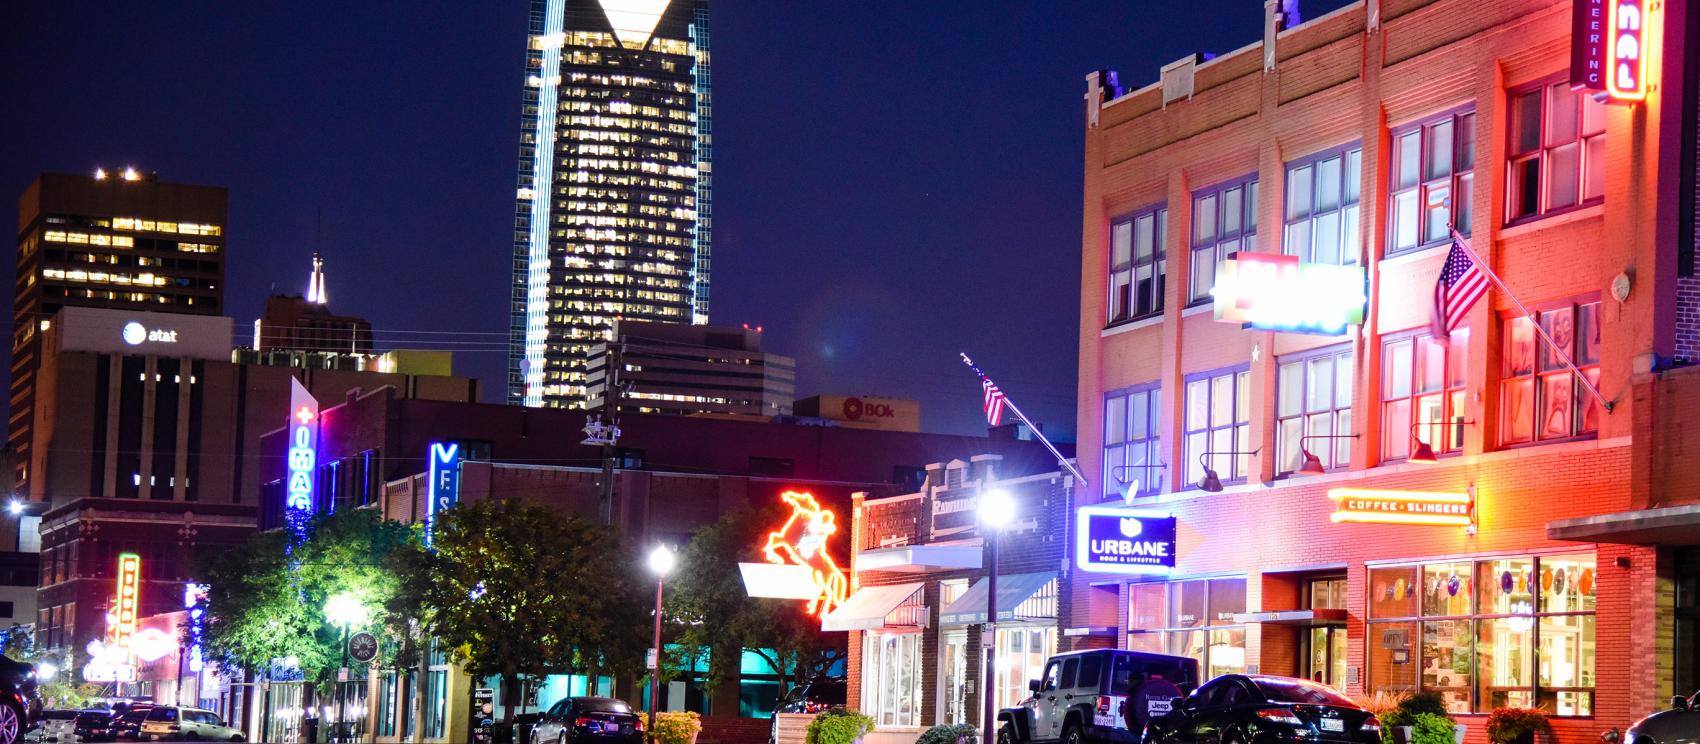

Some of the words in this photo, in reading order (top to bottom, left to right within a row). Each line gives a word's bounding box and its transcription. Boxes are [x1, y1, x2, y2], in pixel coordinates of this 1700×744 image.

[149, 329, 177, 342] at&t
[1349, 500, 1397, 511] COFFEE
[1407, 502, 1467, 513] SLINGERS
[1091, 539, 1169, 556] URBANE
[1126, 556, 1160, 564] LIFESTYLE
[1151, 702, 1169, 710] Jeep
